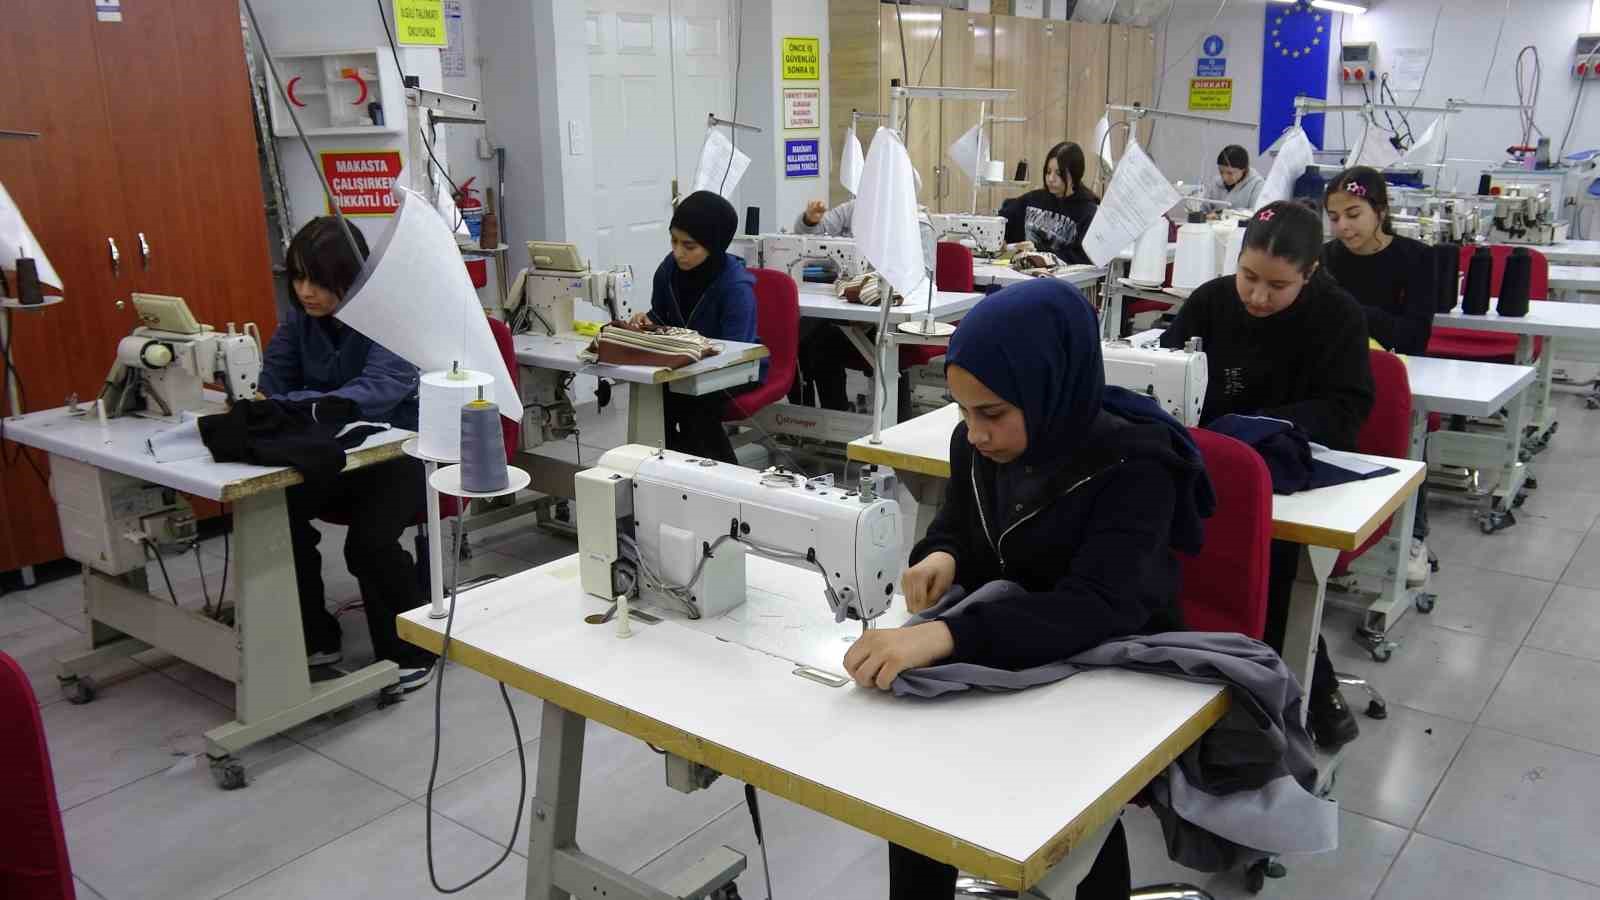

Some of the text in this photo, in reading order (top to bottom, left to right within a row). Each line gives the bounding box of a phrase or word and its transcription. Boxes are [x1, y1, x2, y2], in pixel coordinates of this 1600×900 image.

[789, 42, 805, 52] ÖNCE
[785, 54, 817, 63] GÜVENLİĞİ
[787, 65, 808, 74] SONRA
[335, 160, 388, 172] MAKASTA
